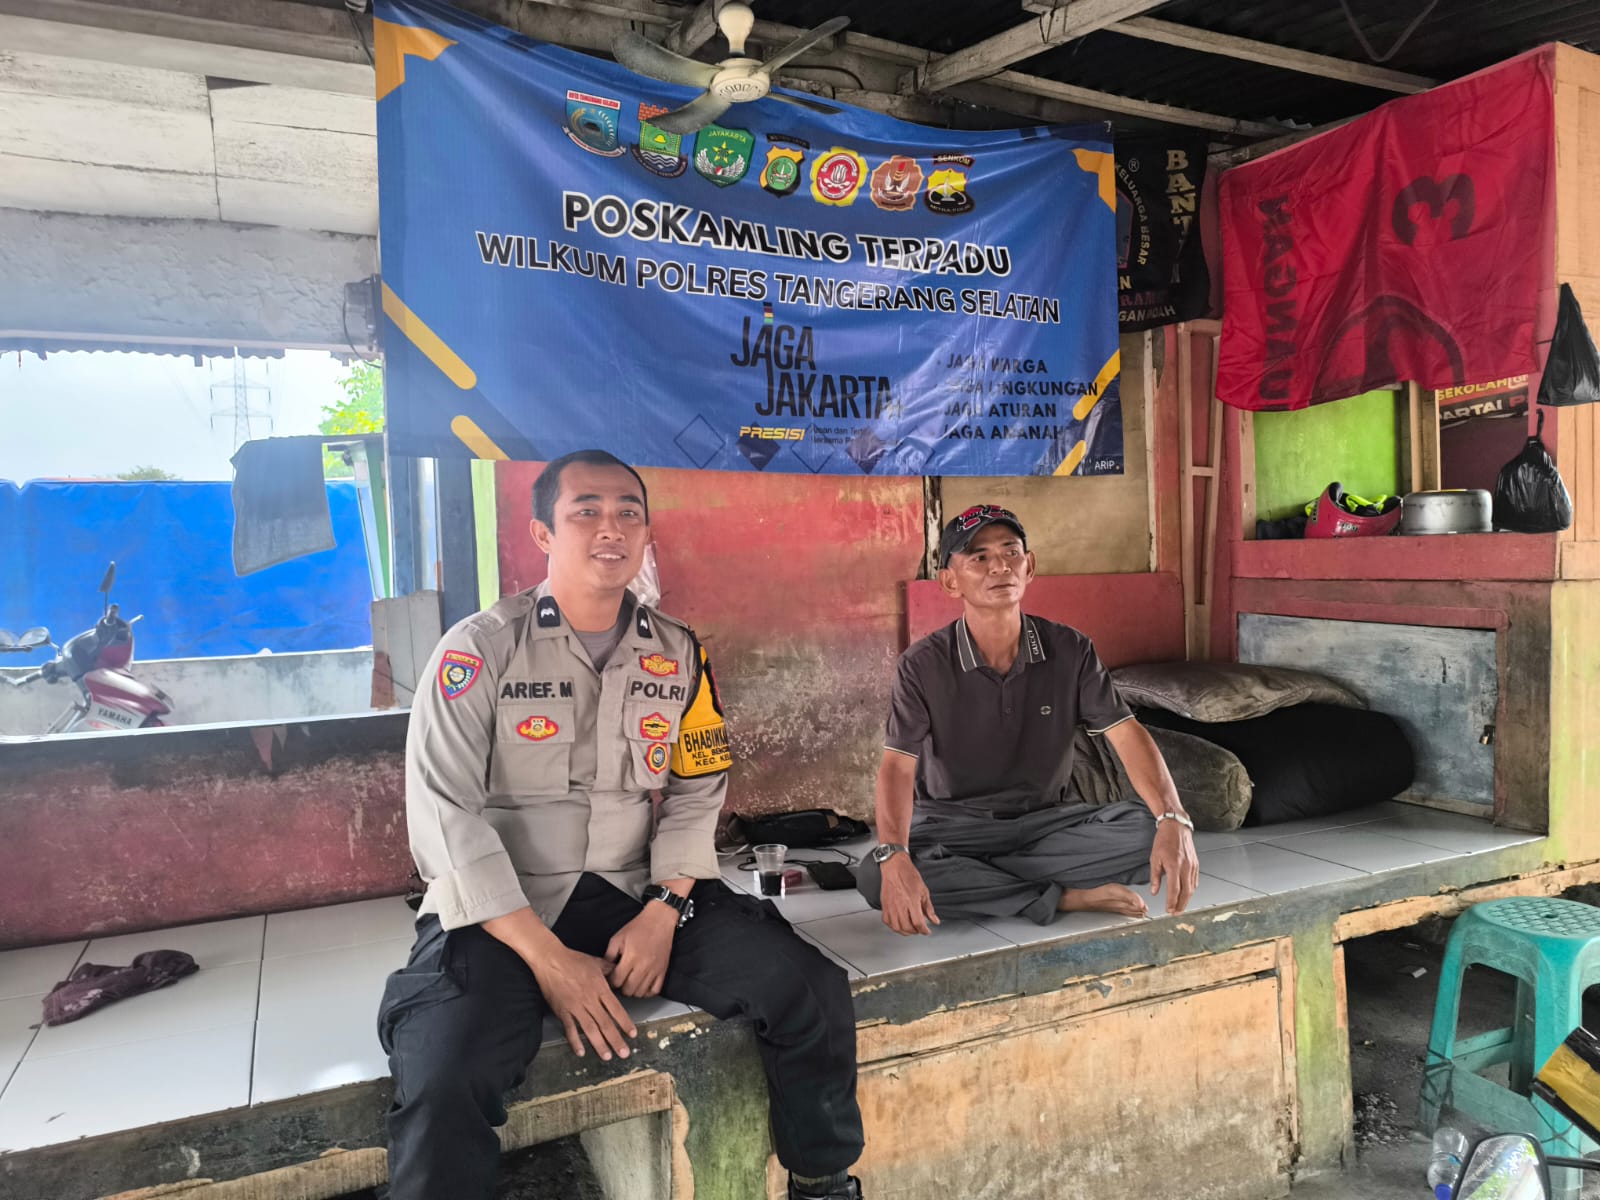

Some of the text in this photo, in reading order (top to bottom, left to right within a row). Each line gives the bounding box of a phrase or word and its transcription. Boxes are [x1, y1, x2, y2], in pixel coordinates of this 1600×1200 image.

[708, 129, 747, 144] JAYAKARTA
[562, 190, 1011, 276] POSKAMLING TERPADU
[1137, 225, 1151, 265] BESAR
[476, 231, 1061, 325] WILKUM POLRES TANGERANG SELATAN
[731, 316, 816, 371] JAGA
[991, 357, 1048, 374] WARGA
[755, 371, 902, 420] JAKARTA
[988, 380, 1098, 396] LNGKUNGAN
[1438, 378, 1508, 401] SEKOLAH
[988, 403, 1057, 418] ATURAN
[739, 425, 806, 441] PRESISI
[990, 425, 1065, 440] AMANAH
[500, 681, 573, 699] ARIEF. M
[630, 680, 686, 702] POLRI
[97, 707, 133, 726] YAMAHA
